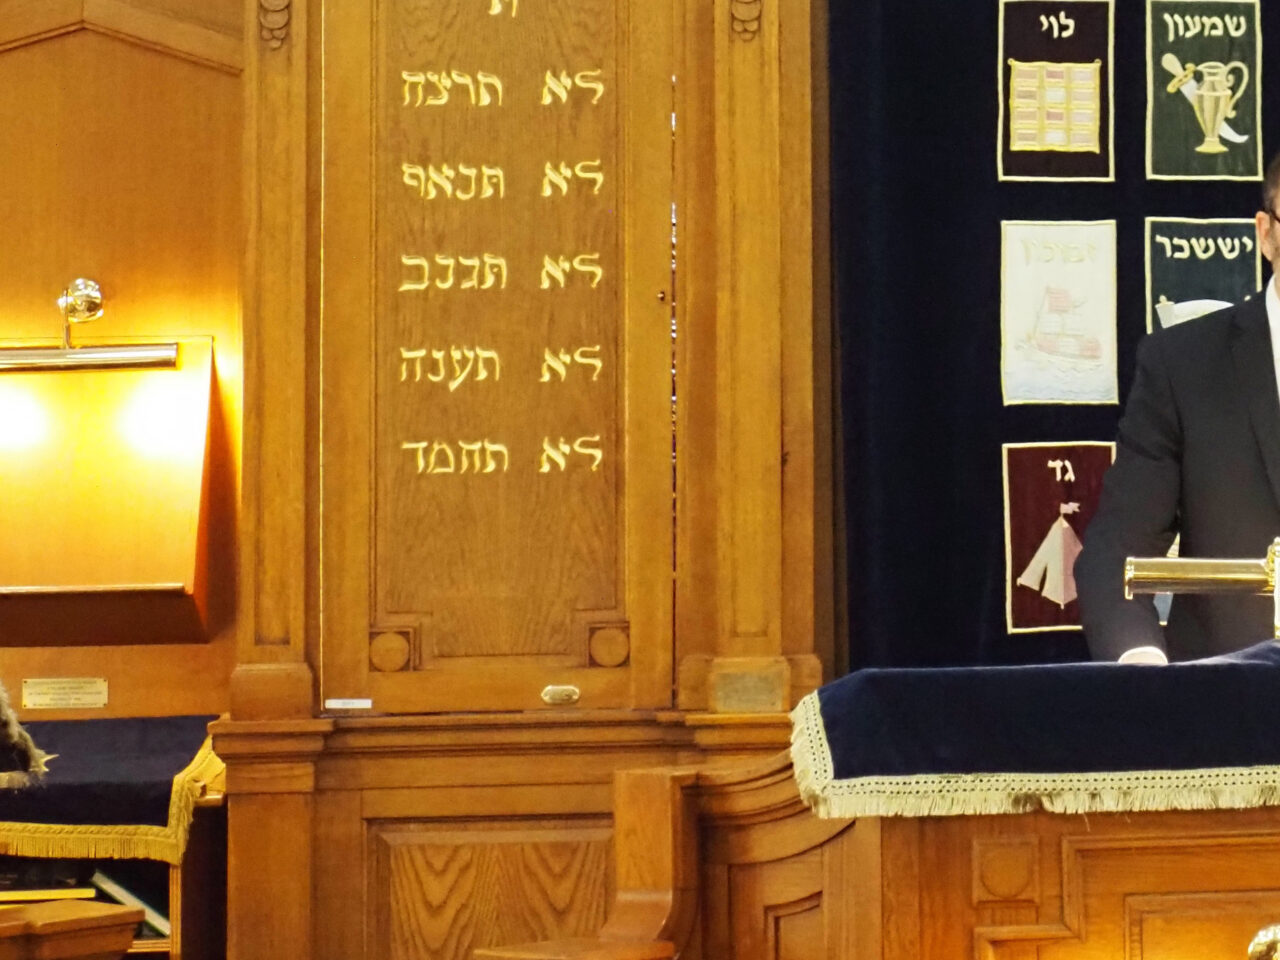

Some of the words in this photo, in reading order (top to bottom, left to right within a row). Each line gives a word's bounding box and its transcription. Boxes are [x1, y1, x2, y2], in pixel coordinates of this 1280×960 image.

[1039, 10, 1076, 39] לוי
[1162, 12, 1248, 43] שמעון
[401, 69, 503, 108] תרצח
[541, 69, 605, 107] לא
[541, 159, 604, 198] לא
[1155, 234, 1254, 260] יששכר
[540, 252, 603, 290] לא
[399, 344, 501, 393] תענה
[540, 344, 603, 383] לא
[400, 437, 509, 475] תחמד
[539, 434, 603, 474] לא
[1046, 458, 1076, 483] גד
